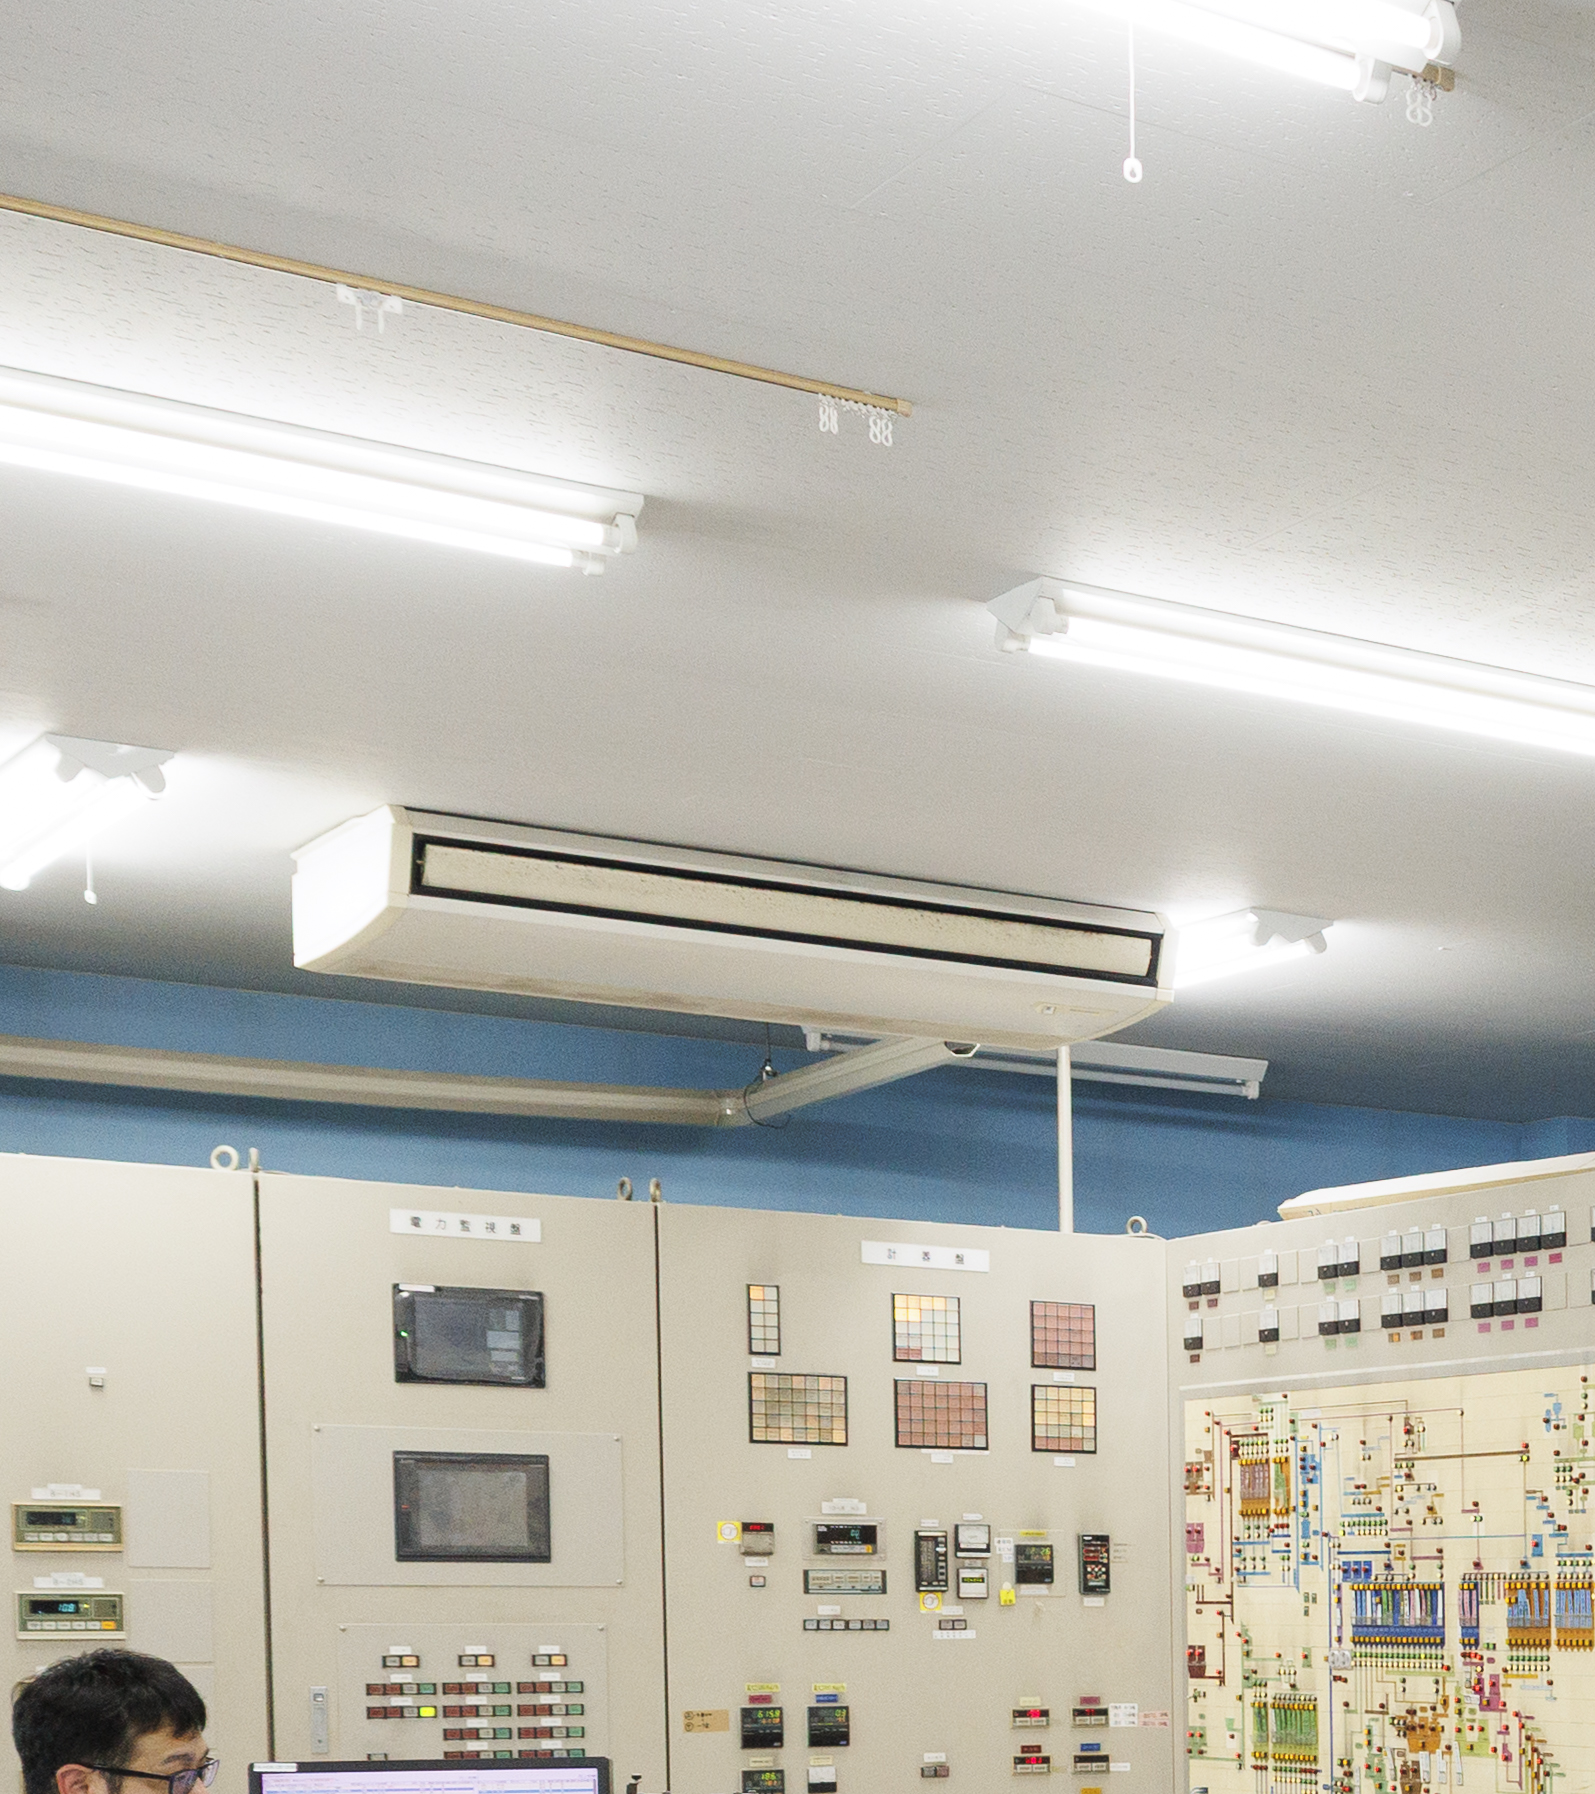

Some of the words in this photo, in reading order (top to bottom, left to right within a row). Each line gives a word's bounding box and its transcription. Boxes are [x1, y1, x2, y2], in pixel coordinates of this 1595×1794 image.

[409, 1216, 523, 1237] 電力監視盤
